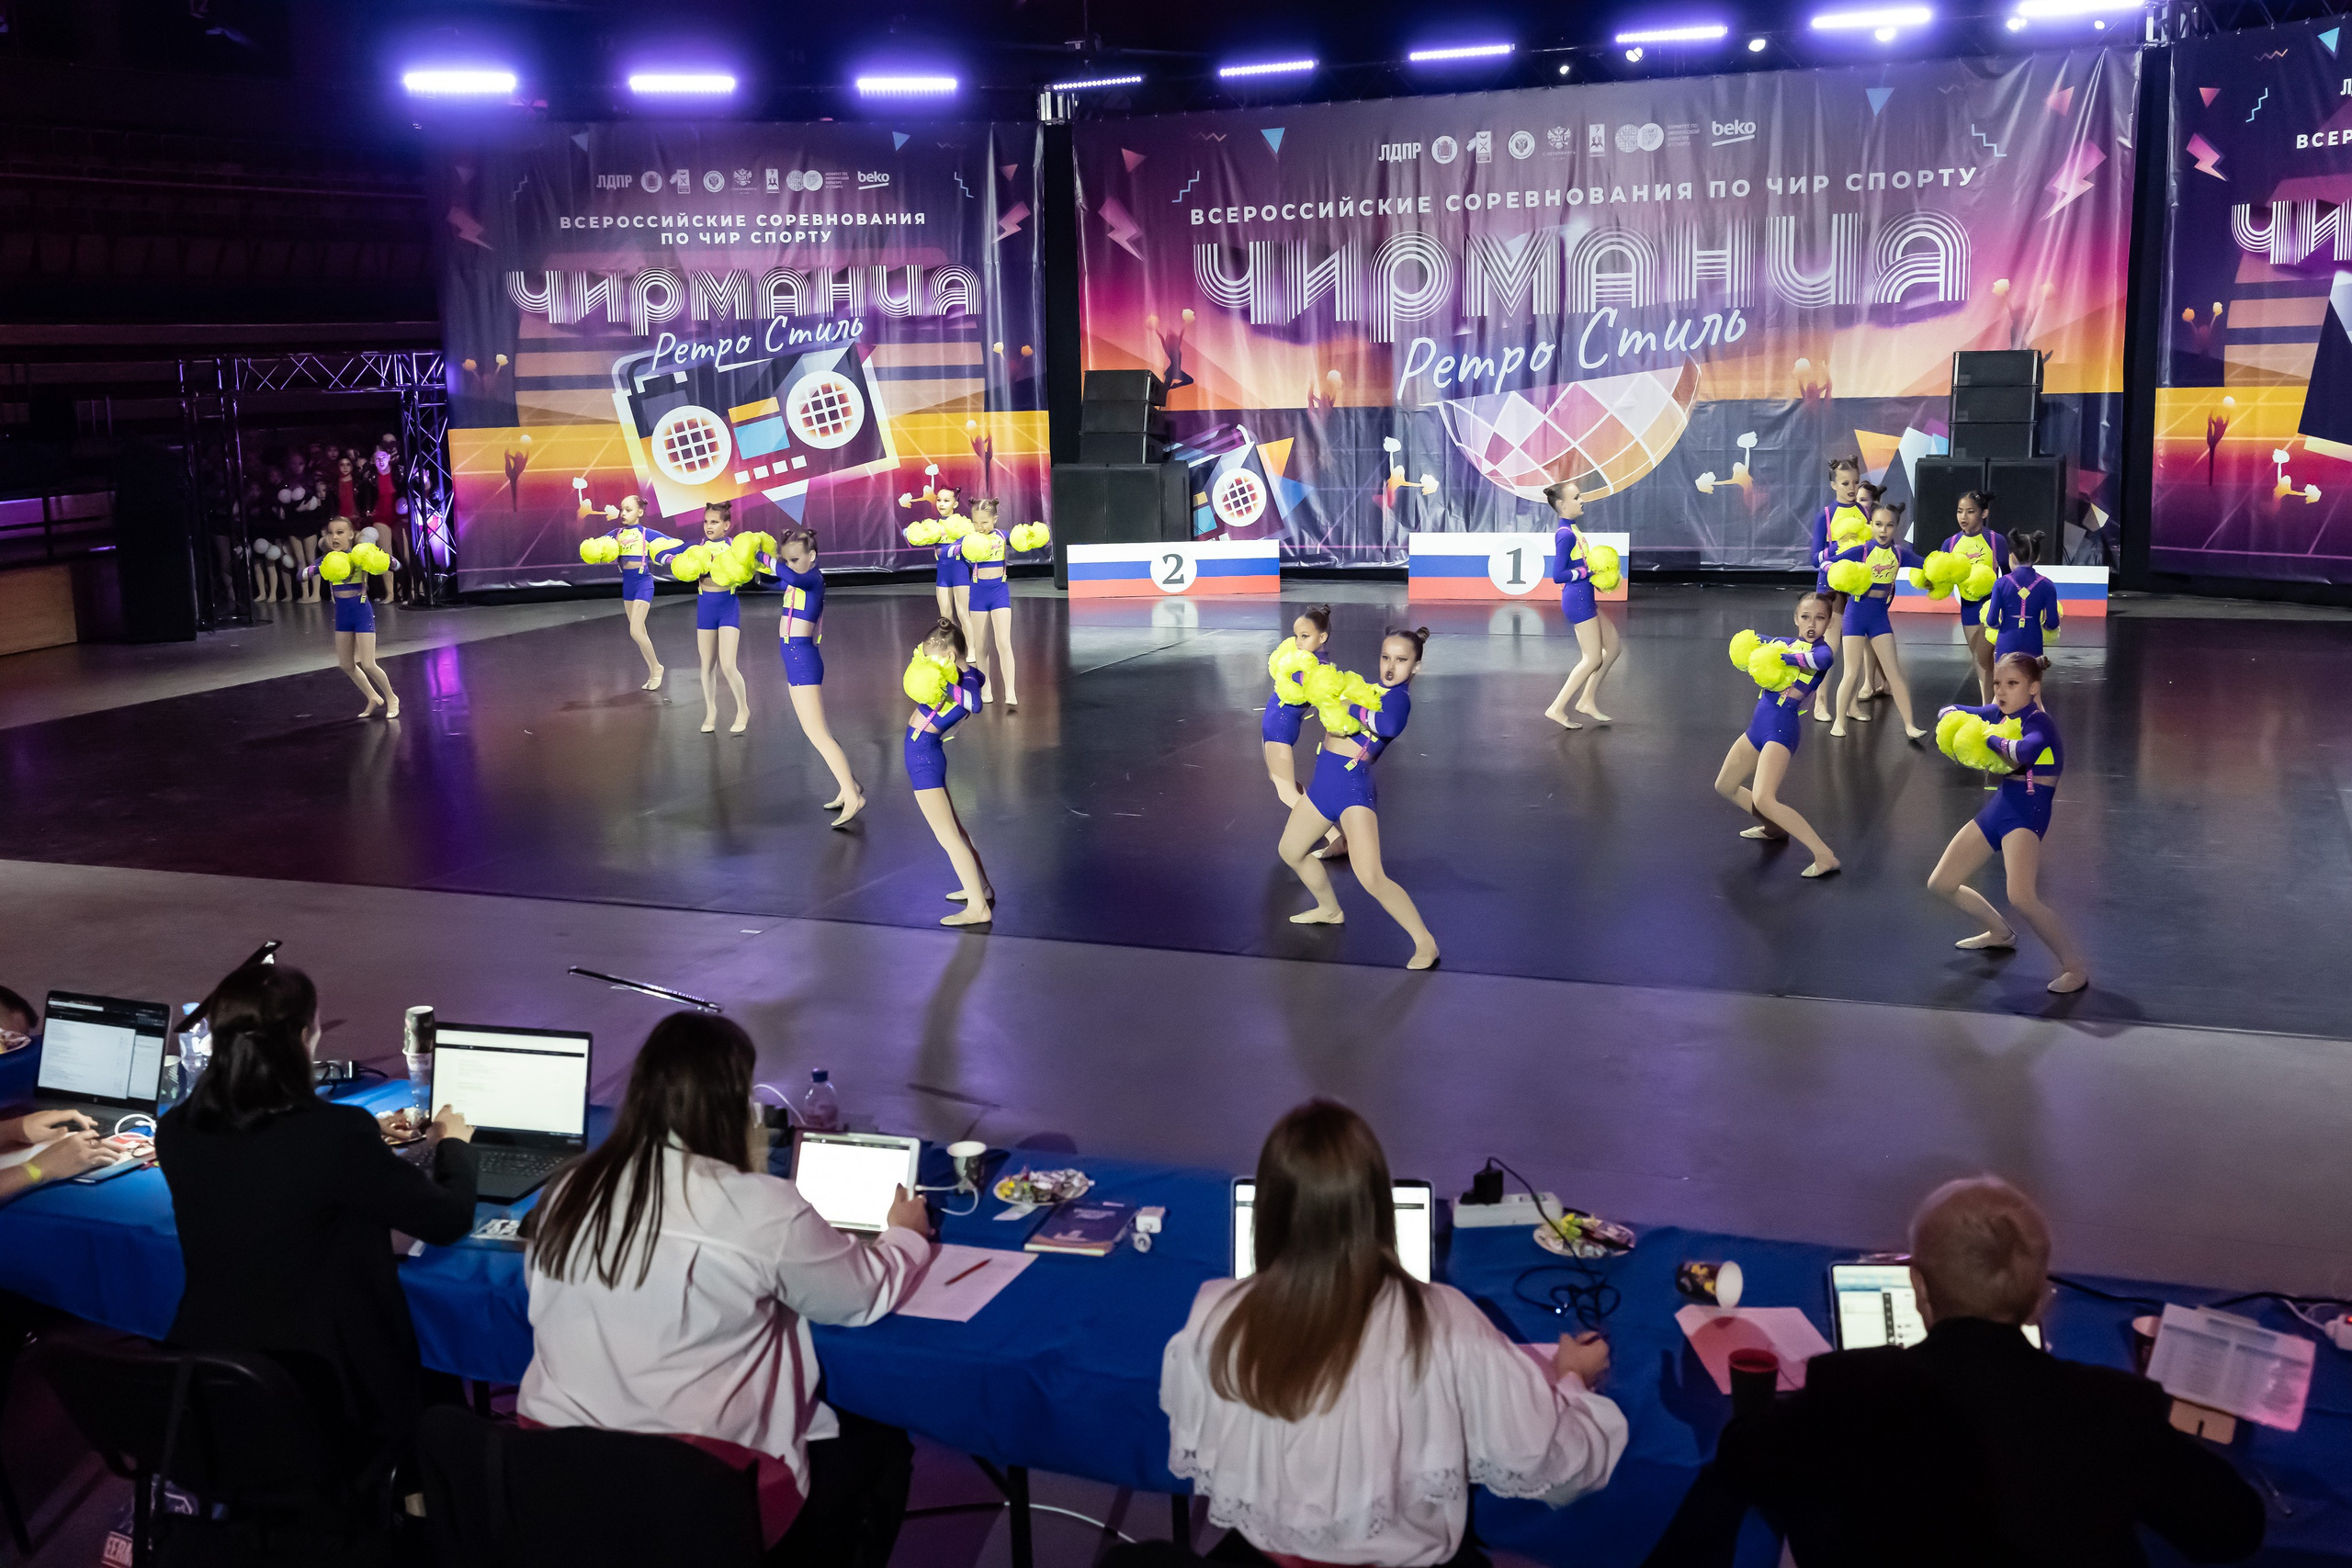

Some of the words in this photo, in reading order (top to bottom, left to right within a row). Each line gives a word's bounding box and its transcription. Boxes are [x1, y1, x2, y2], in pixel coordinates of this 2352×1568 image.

[1712, 119, 1757, 136] beko
[1378, 141, 1421, 163] ЛДПР
[596, 174, 633, 190] ЛДПР
[857, 170, 890, 184] beko
[1191, 196, 1431, 225] ВСЕРОССИЙСКИЕ
[1445, 182, 1692, 212] СОРЕВНОВАНИЯ
[1710, 179, 1751, 198] ПО
[1767, 175, 1830, 196] ЧИР
[1846, 167, 1977, 192] СПОРТУ
[560, 212, 746, 229] ВСЕРОССИЙСКИЕ
[756, 212, 926, 227] СОРЕВНОВАНИЯ
[661, 232, 689, 245] ПО
[699, 231, 741, 245] ЧИР
[751, 231, 832, 243] СПОРТУ
[651, 332, 752, 372] Ретро
[765, 315, 864, 352] Стиль
[1396, 336, 1556, 400] Ретро
[1577, 306, 1747, 369] Стиль
[1162, 553, 1185, 585] 2
[1506, 547, 1527, 585] 1
